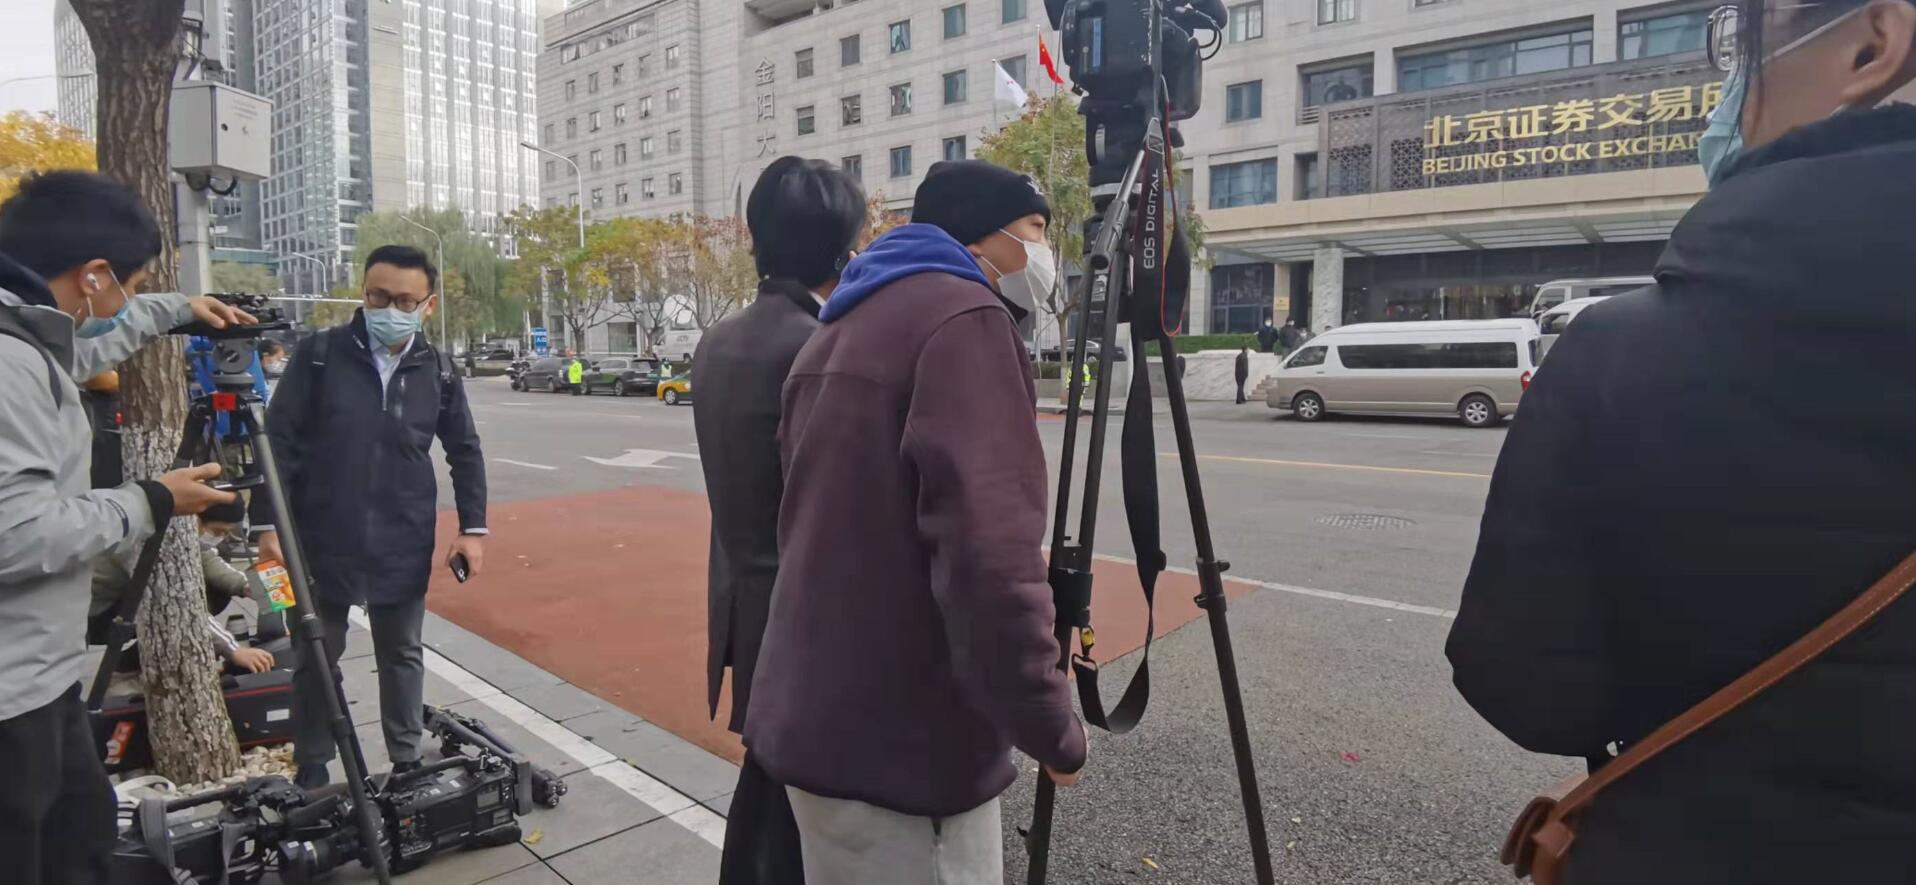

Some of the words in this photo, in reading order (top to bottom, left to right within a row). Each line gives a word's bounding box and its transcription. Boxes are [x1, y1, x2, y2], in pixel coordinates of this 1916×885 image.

[1423, 151, 1507, 175] BEIJING
[1513, 142, 1592, 166] STOCK
[1146, 168, 1160, 232] DIGITAL
[1144, 236, 1155, 269] EOS
